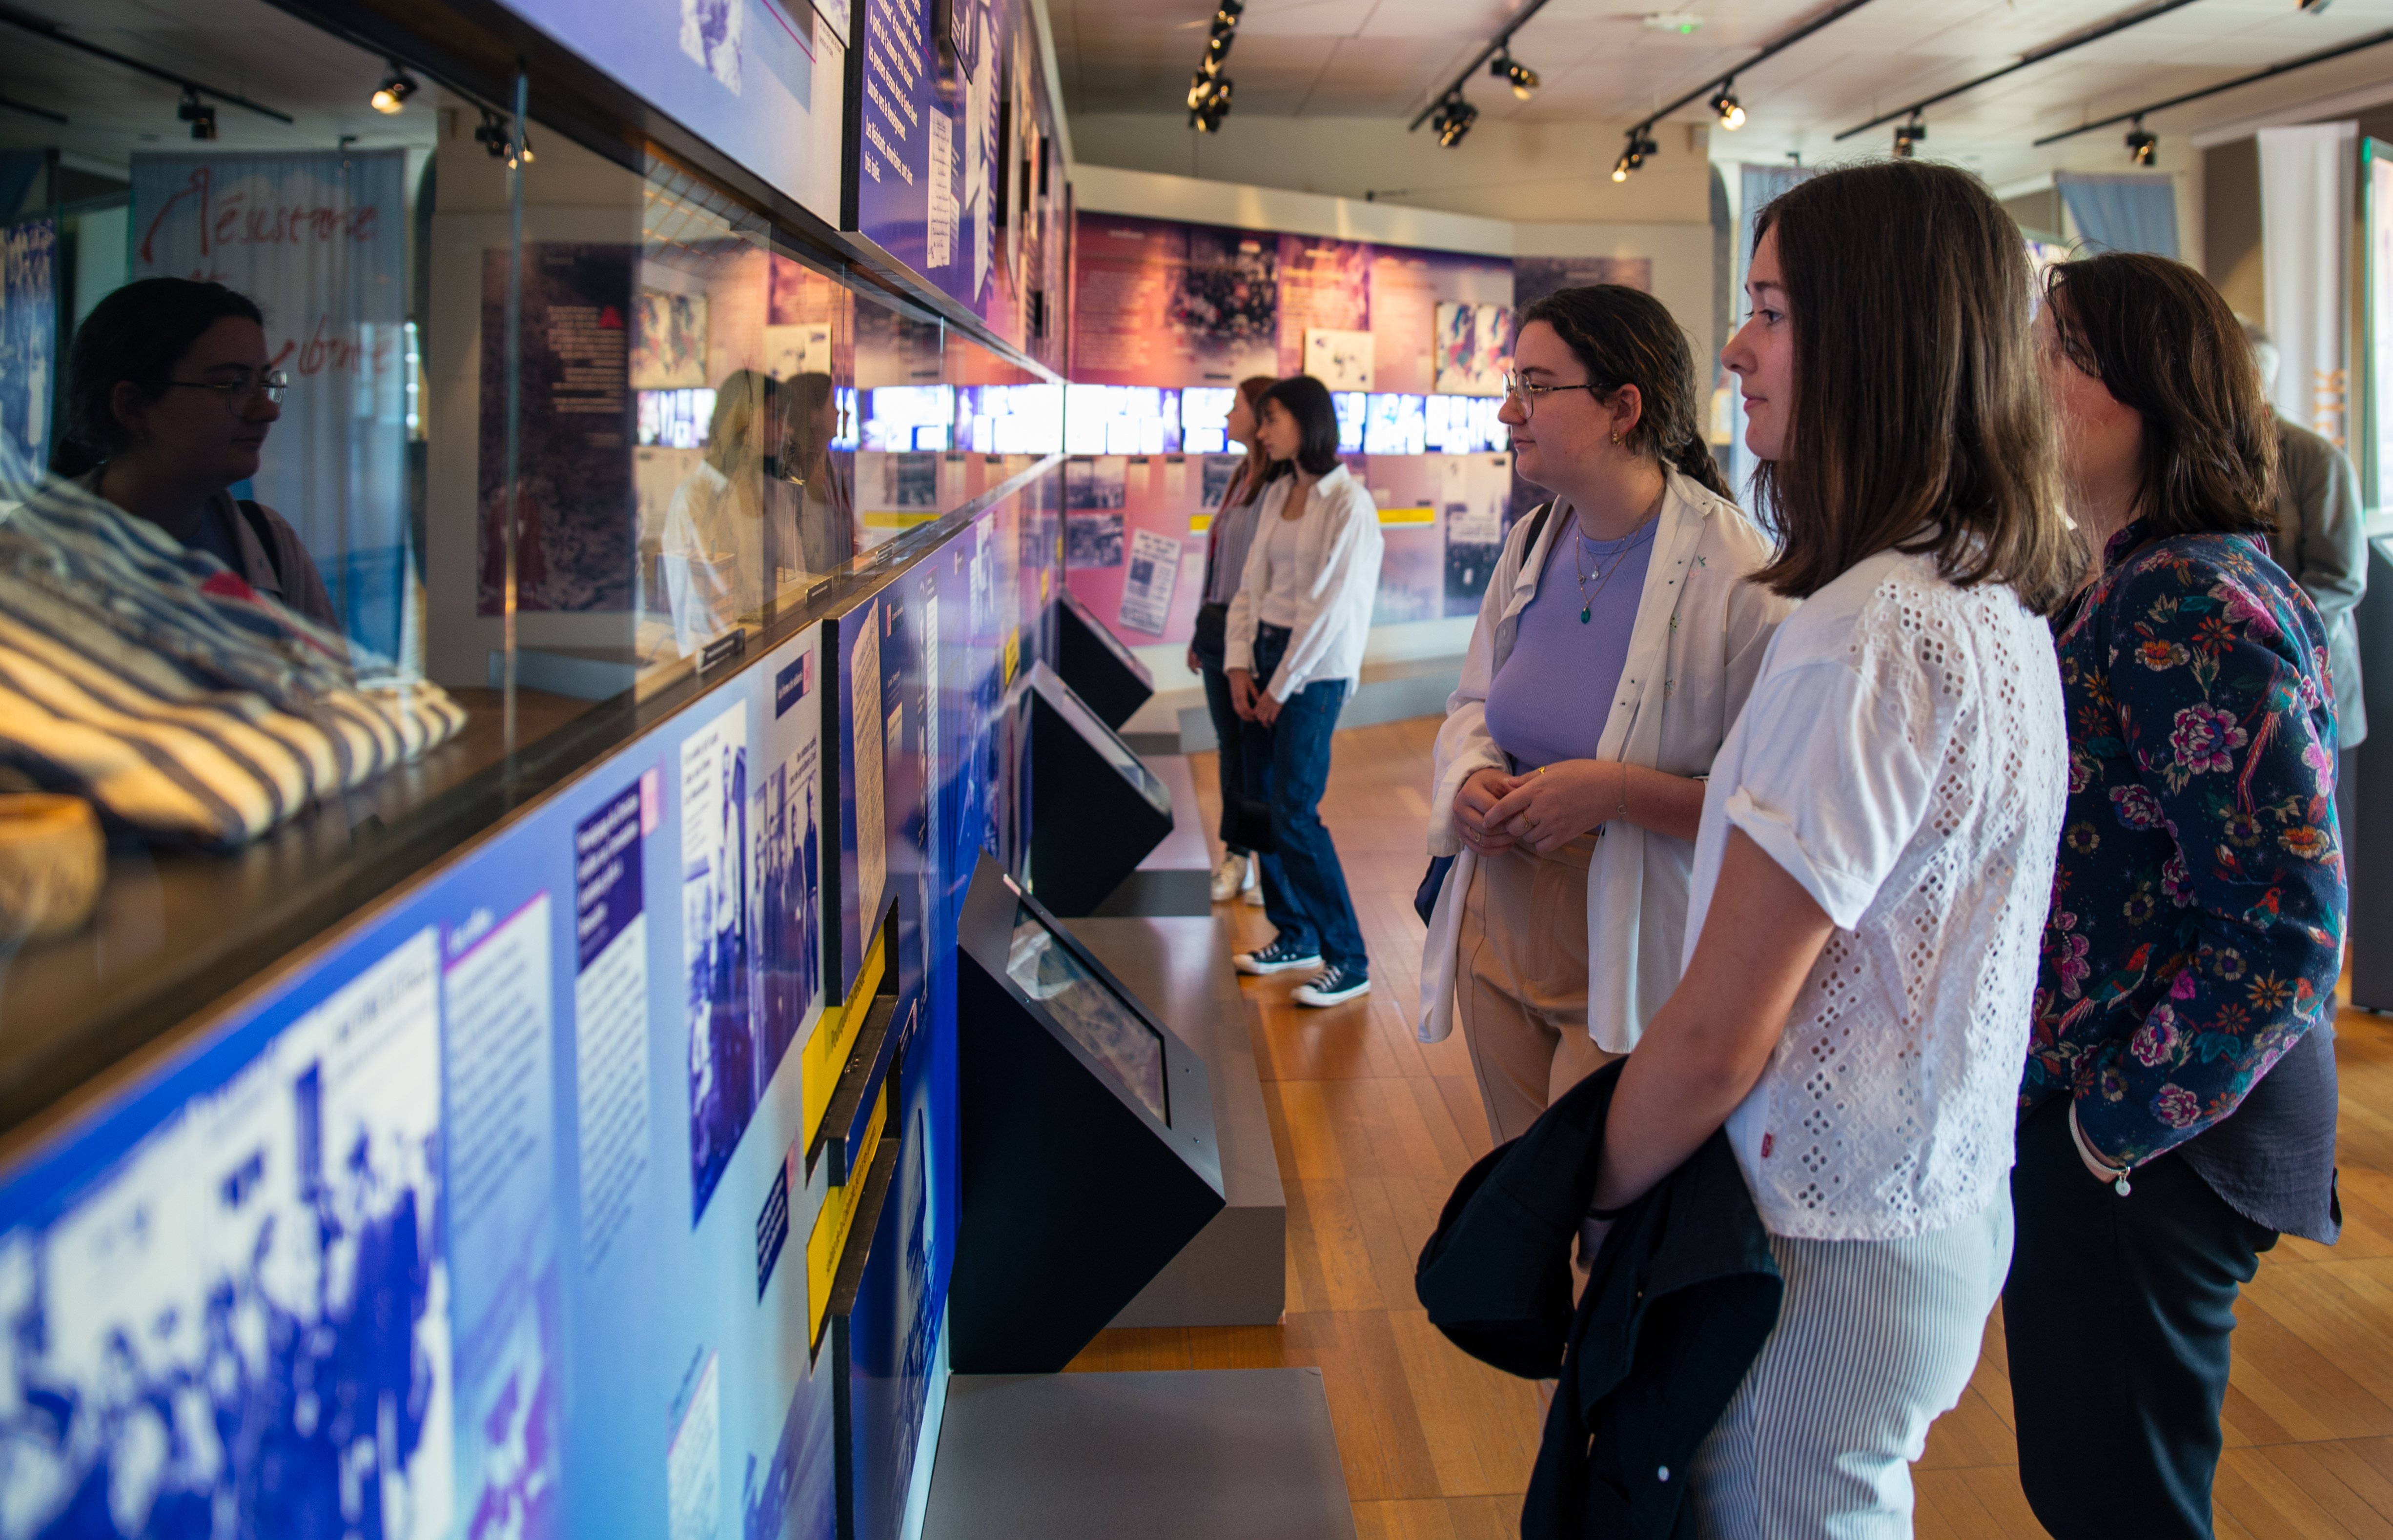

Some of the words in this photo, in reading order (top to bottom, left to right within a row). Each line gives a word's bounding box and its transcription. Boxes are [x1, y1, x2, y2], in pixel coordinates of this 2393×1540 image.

[873, 14, 881, 39] partir
[881, 24, 885, 46] de
[885, 29, 898, 66] l'automne
[873, 51, 886, 81] premiers
[885, 66, 896, 96] réseaux
[901, 88, 904, 108] le
[868, 74, 879, 105] tournés
[884, 96, 888, 117] le
[887, 101, 906, 142] Renseignement.
[871, 122, 886, 159] Résistants,
[886, 142, 901, 177] minoritaires,
[871, 156, 881, 183] isolés.
